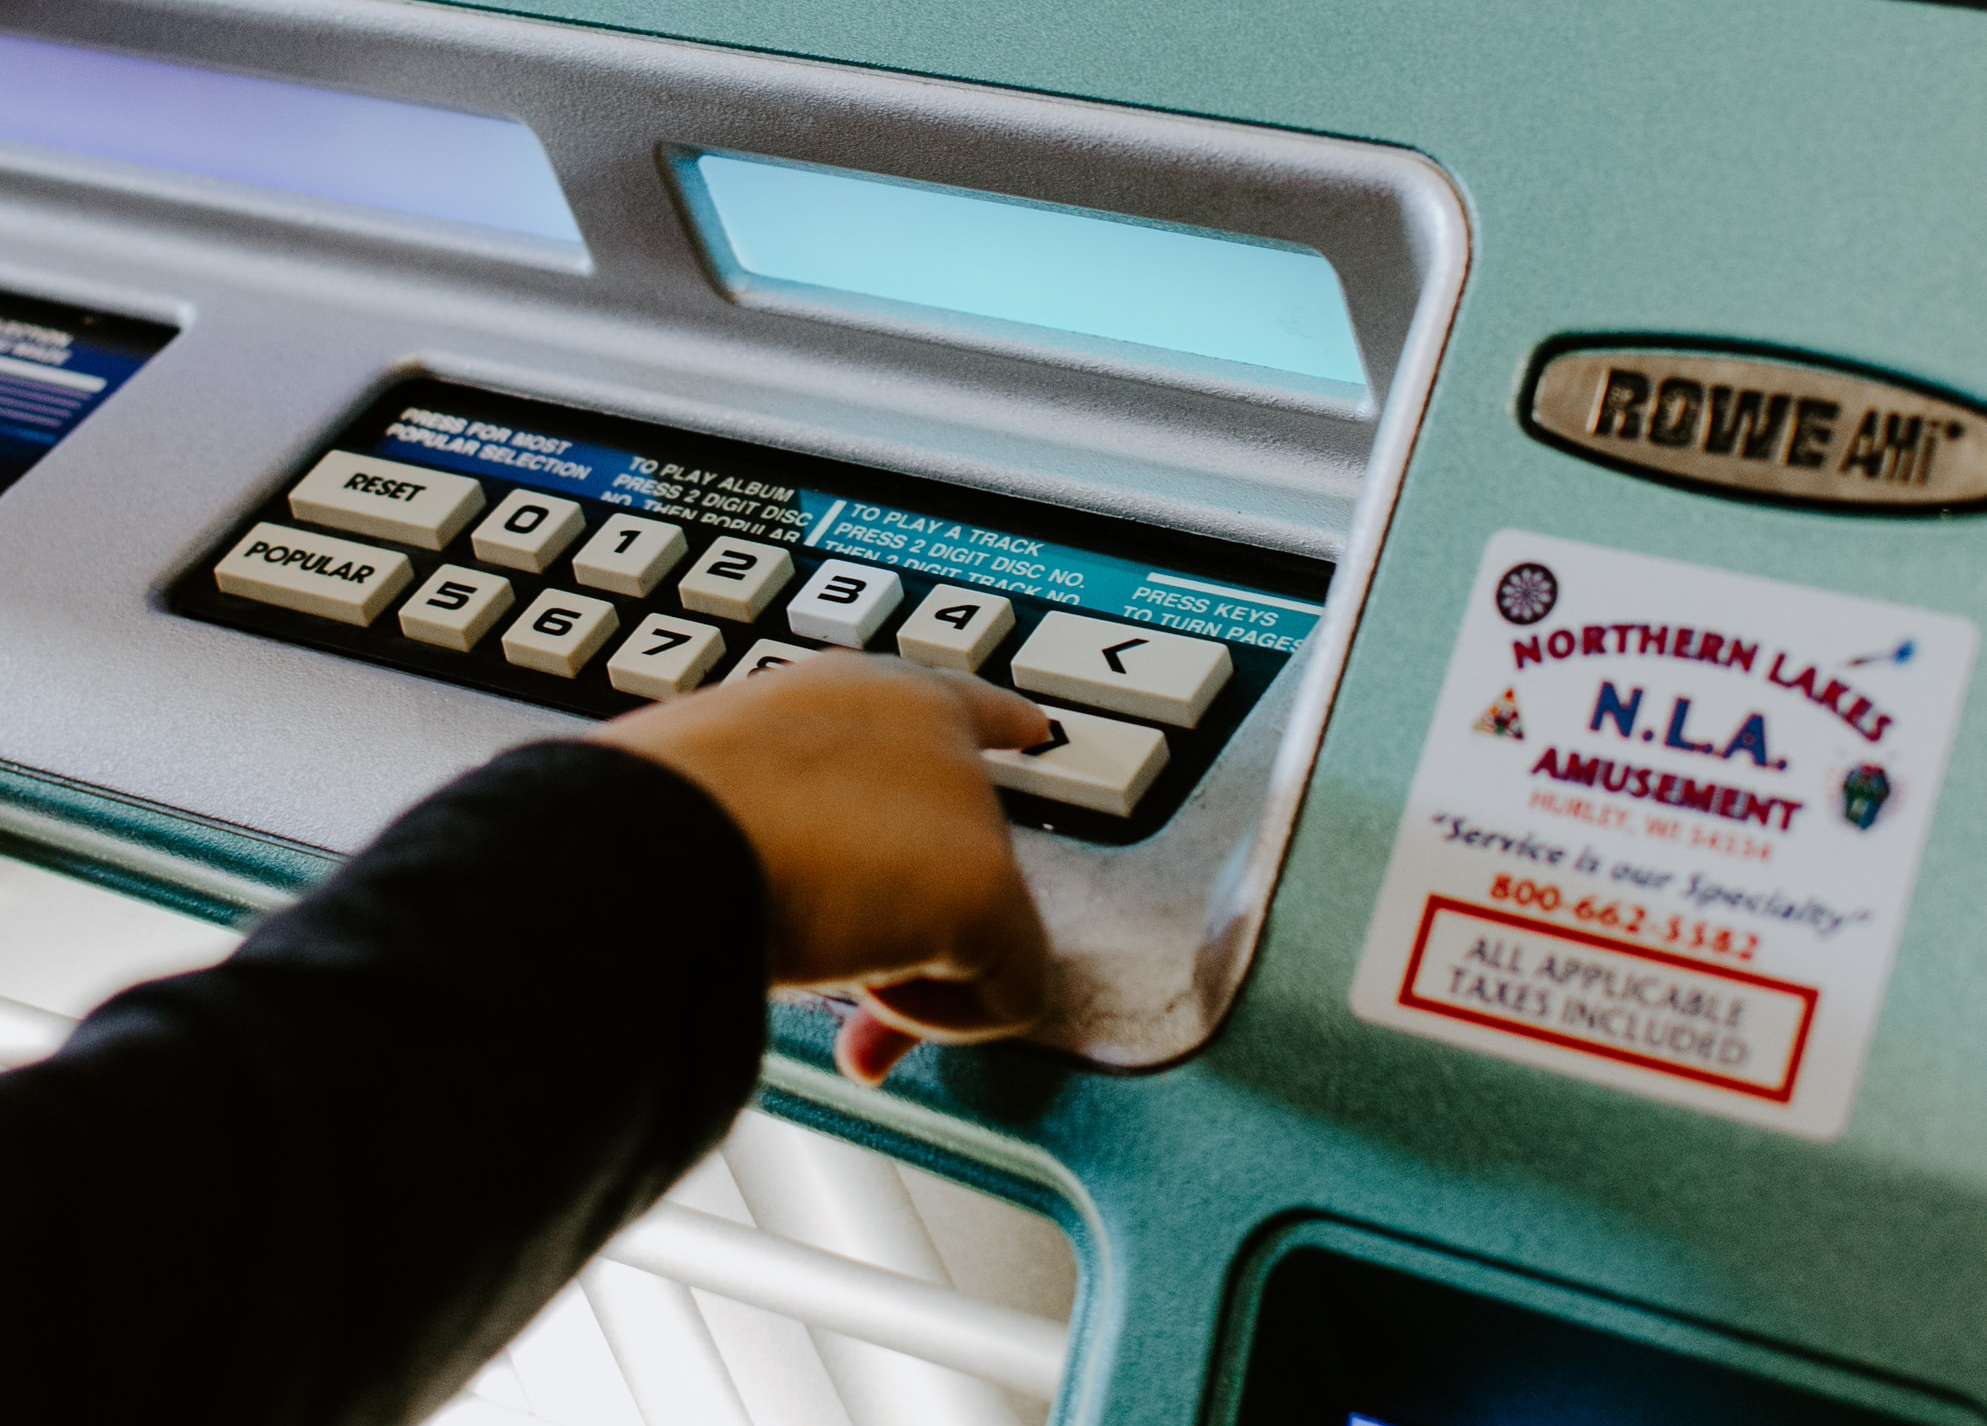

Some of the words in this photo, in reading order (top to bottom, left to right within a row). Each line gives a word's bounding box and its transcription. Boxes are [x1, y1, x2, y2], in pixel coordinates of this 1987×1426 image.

[400, 407, 468, 434] PRESS
[467, 421, 511, 443] FOR
[511, 432, 572, 455] MOST
[1587, 368, 1840, 469] ROWE
[385, 422, 480, 456] POPULAR
[478, 444, 592, 480] SELECTION
[343, 473, 426, 502] RESET
[612, 473, 683, 499] PRESS
[684, 490, 701, 503] 2
[702, 493, 761, 515] DIGIT
[761, 508, 813, 527] DISC
[629, 456, 658, 474] TO
[660, 464, 718, 485] PLAY
[718, 476, 795, 503] ALBUM
[504, 504, 549, 534] 0
[851, 503, 881, 521] TO
[883, 511, 943, 534] PLAY
[945, 525, 962, 539] A
[968, 528, 1045, 557] TRACK
[244, 540, 375, 585] POPULAR
[614, 530, 643, 554] 1
[824, 540, 881, 561] THEN
[834, 522, 908, 549] PRESS
[909, 539, 926, 554] 2
[928, 544, 992, 567] DIGIT
[991, 556, 1045, 579] DISC
[1048, 569, 1085, 589] NO.
[706, 550, 758, 580] 2
[426, 581, 478, 611] 5
[817, 575, 867, 605] 3
[1131, 586, 1210, 613] PRESS
[1214, 603, 1279, 627] KEYS
[532, 608, 583, 637] 6
[934, 604, 981, 630] 4
[1123, 605, 1152, 622] TO
[1160, 613, 1223, 637] TURN
[641, 628, 692, 655] 7
[1513, 624, 1760, 673] NORTHERN
[1768, 653, 1894, 743] LAKES
[1589, 680, 1790, 770] N.L.A.
[1531, 747, 1803, 832] AMUSEMENT
[1645, 816, 1680, 839] WI
[1573, 845, 1600, 874] is
[1610, 862, 1673, 888] our
[1465, 937, 1522, 973] ALL
[1535, 954, 1747, 1028] APPLICABLE
[1448, 964, 1550, 1016] TAXES
[1561, 996, 1749, 1064] INCLUDED
